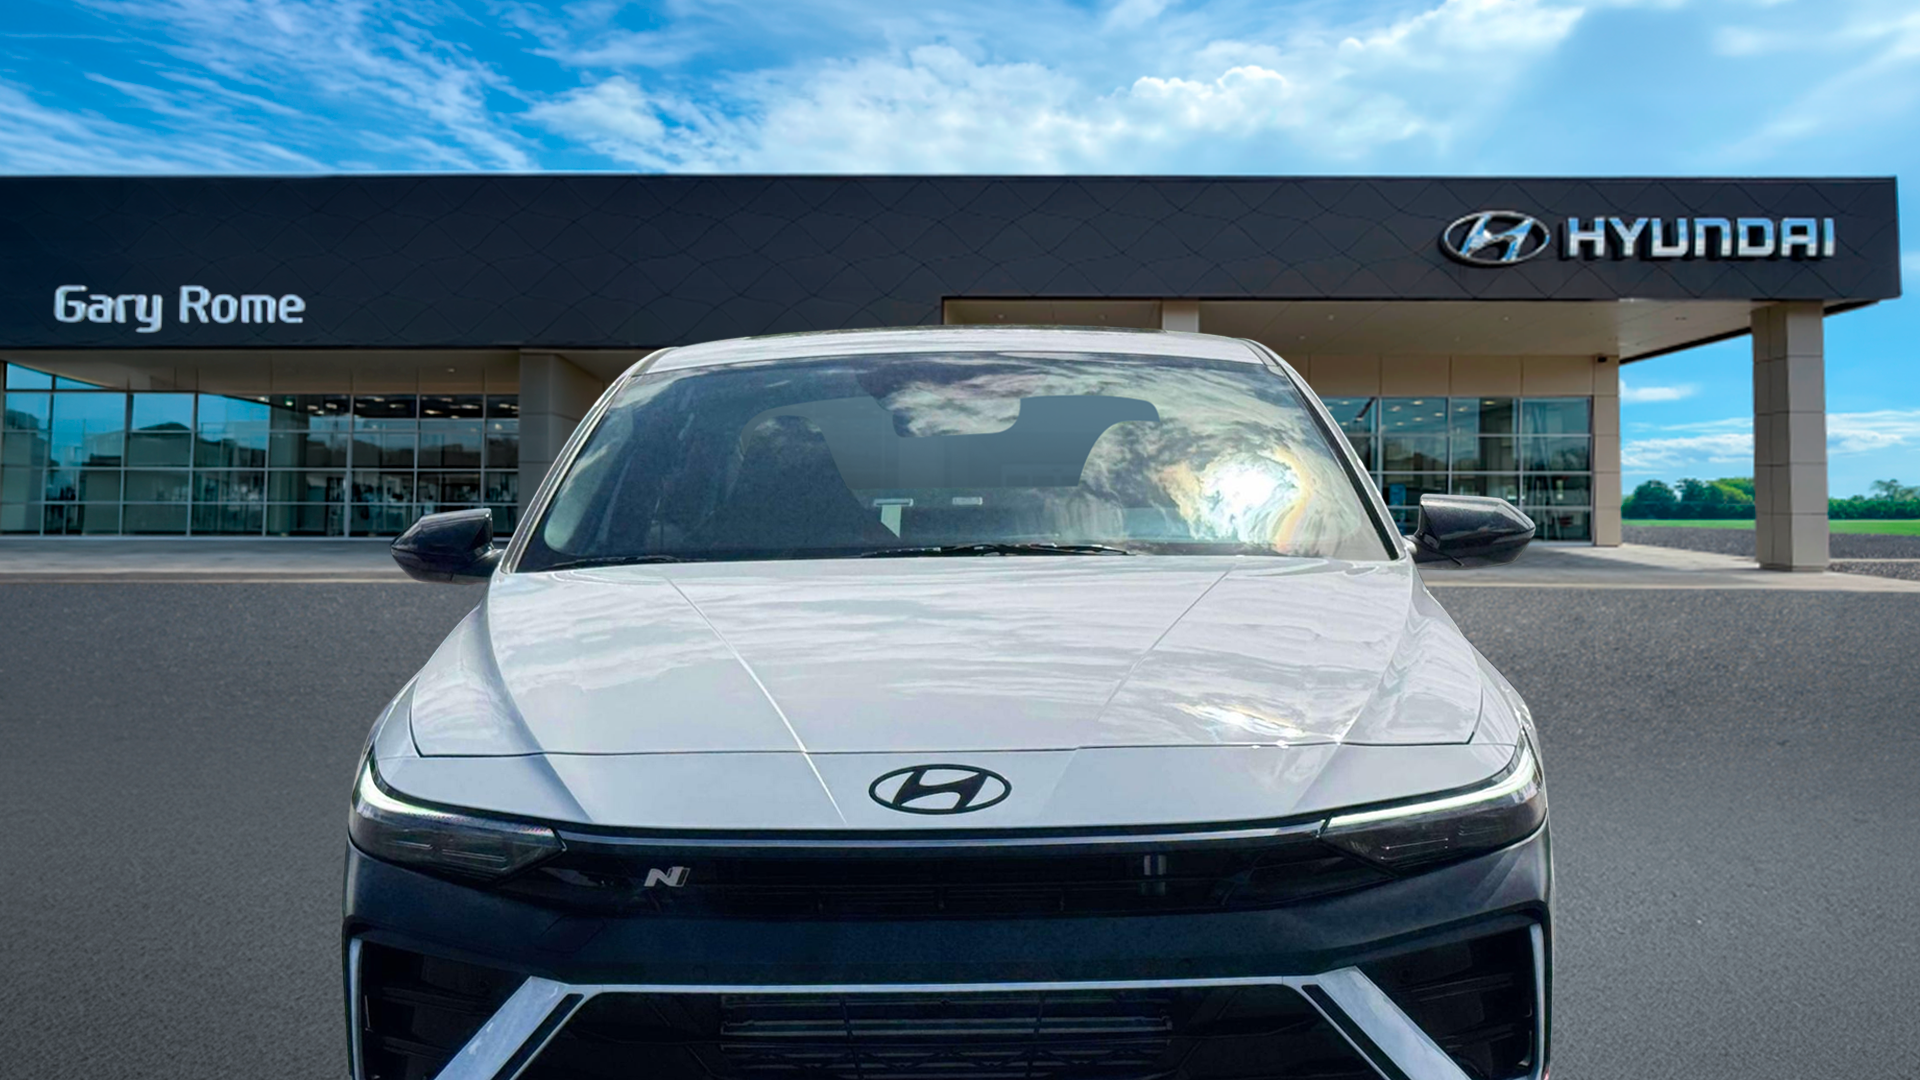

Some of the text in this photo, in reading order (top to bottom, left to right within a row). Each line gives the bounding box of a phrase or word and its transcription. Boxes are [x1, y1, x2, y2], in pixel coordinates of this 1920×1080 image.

[1567, 216, 1836, 257] HYUNDAI
[54, 285, 306, 333] Gary Rome
